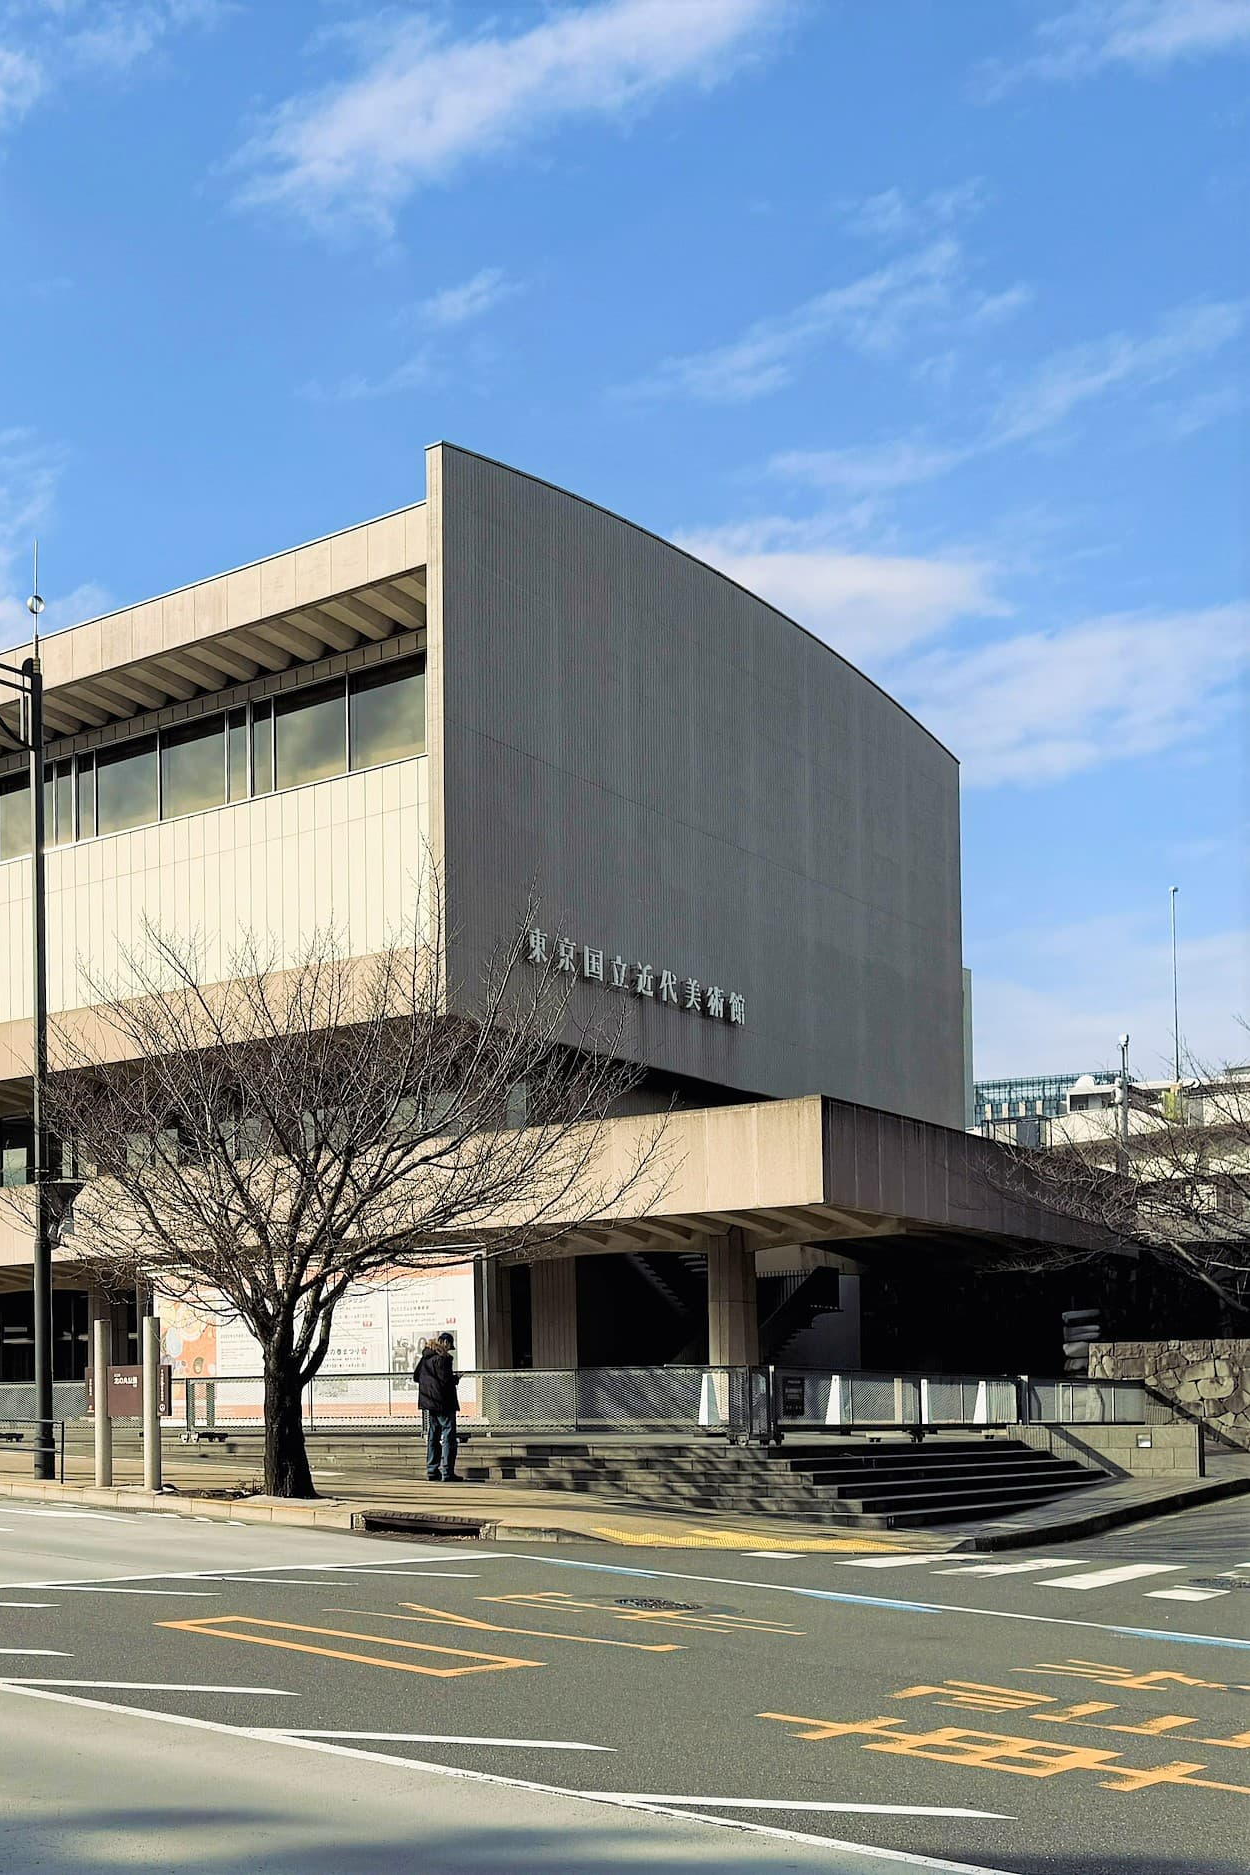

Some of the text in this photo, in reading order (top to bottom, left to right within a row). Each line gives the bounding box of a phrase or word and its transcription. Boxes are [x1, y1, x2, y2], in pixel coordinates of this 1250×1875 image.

[527, 927, 746, 1025] 東京国立近代美術館
